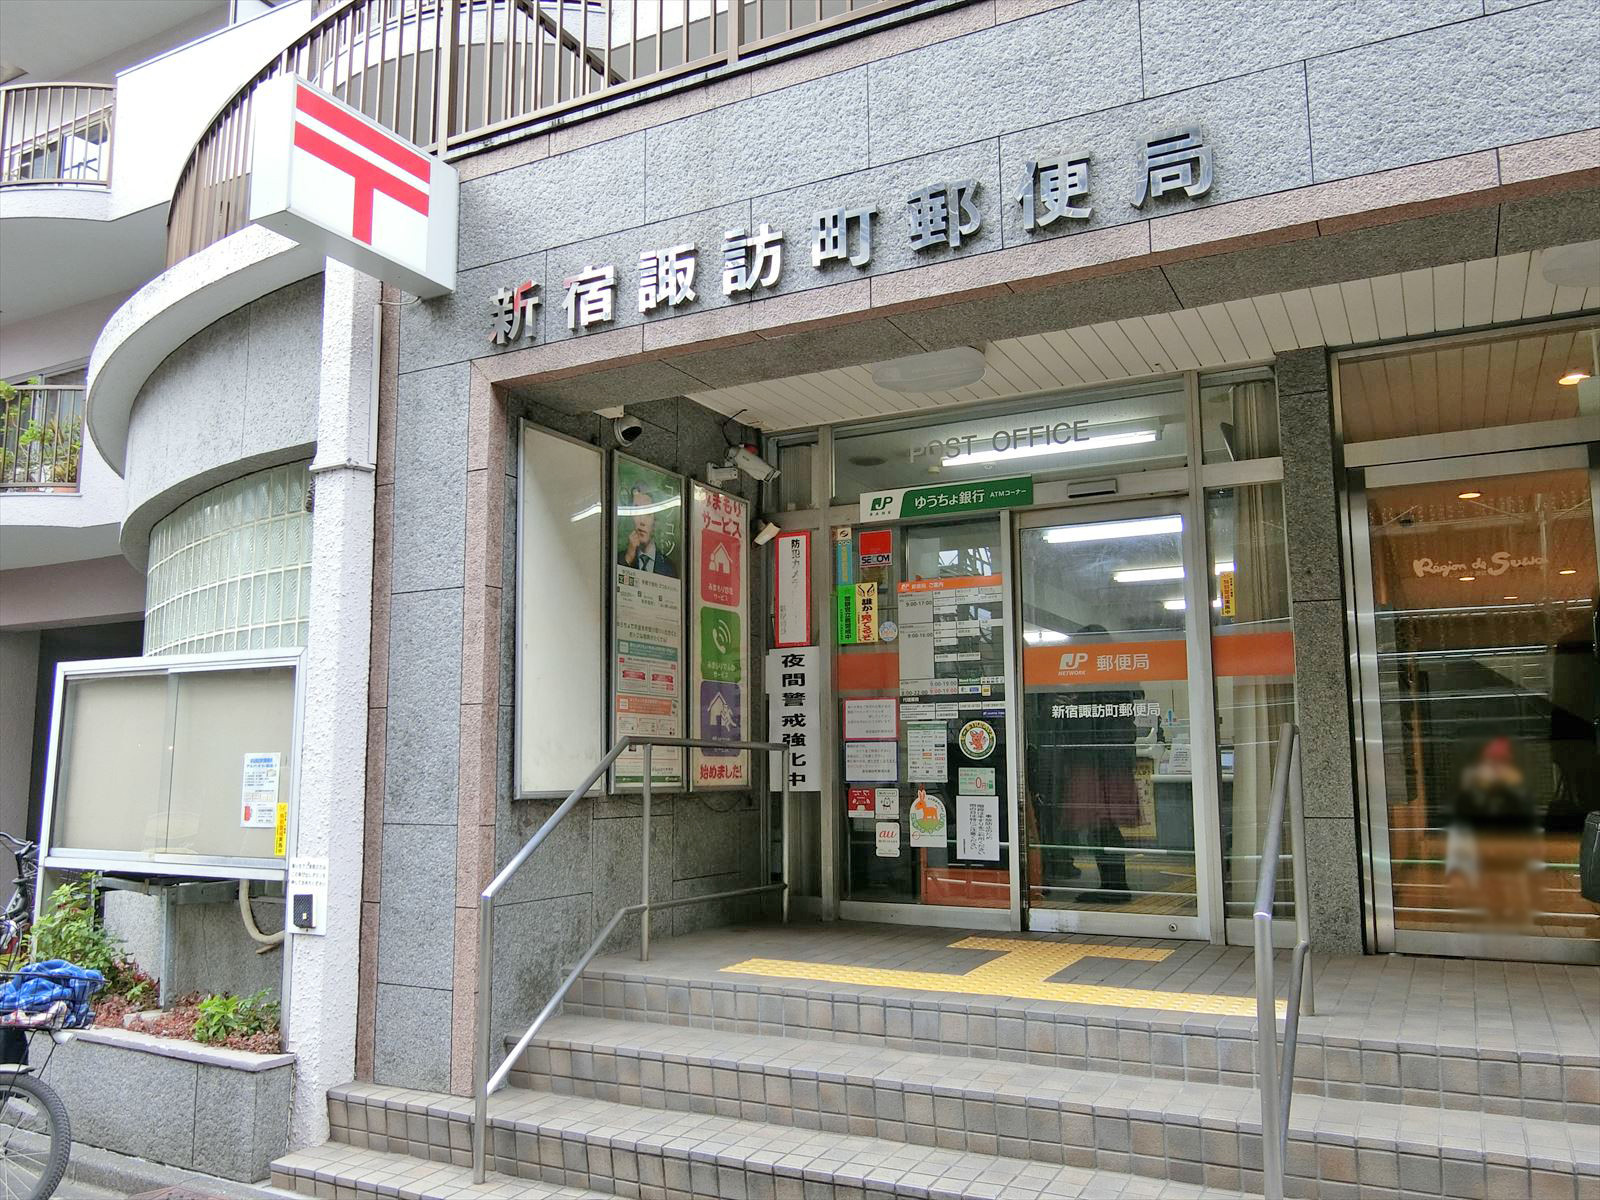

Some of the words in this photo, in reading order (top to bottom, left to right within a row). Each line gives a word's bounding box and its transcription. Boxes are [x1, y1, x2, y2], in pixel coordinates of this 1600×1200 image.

[487, 124, 1214, 347] 新宿諏訪町郵便局
[908, 434, 978, 464] POST
[992, 419, 1090, 452] OFFICE
[914, 489, 985, 510] ゆうちょ銀行
[989, 489, 1027, 498] ATMコーナー
[702, 513, 743, 539] サービス
[1412, 557, 1468, 578] Région
[1471, 557, 1488, 570] de
[1096, 653, 1151, 672] 郵便局
[1051, 702, 1162, 719] 新宿諏訪町郵便局
[700, 764, 743, 780] 始めました!
[879, 829, 897, 838] au
